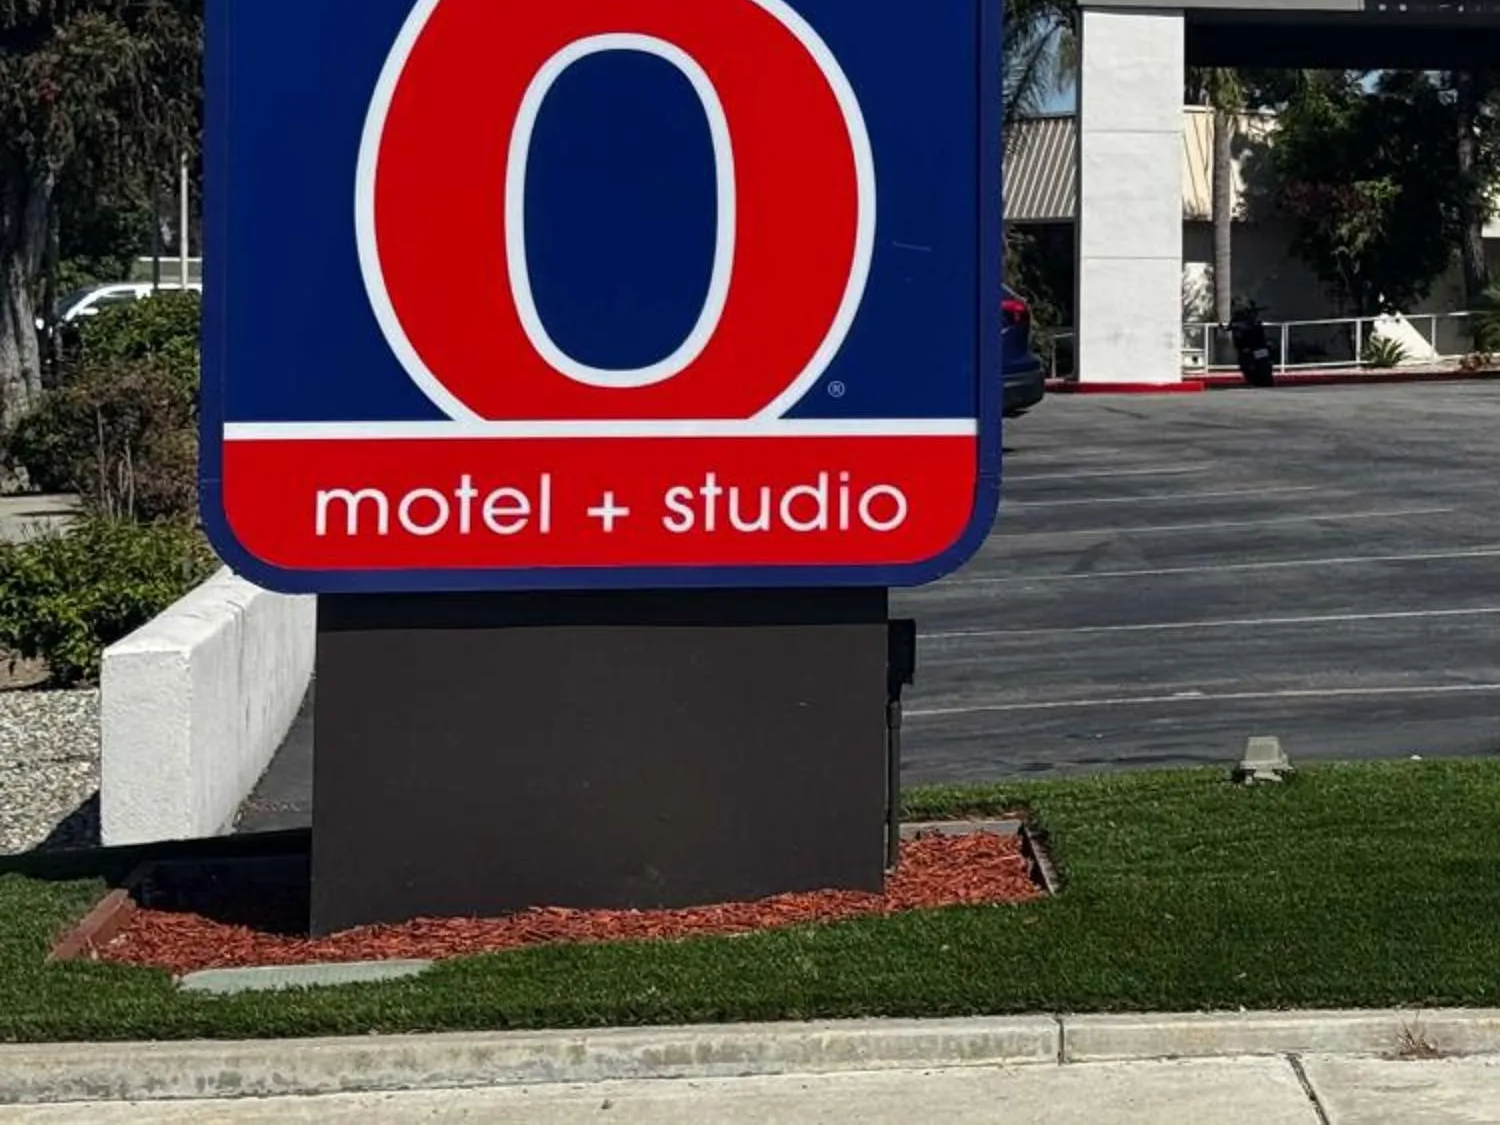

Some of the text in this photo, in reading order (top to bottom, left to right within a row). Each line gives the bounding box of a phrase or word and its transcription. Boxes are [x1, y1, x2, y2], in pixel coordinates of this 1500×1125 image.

[315, 472, 908, 536] motel + studio
